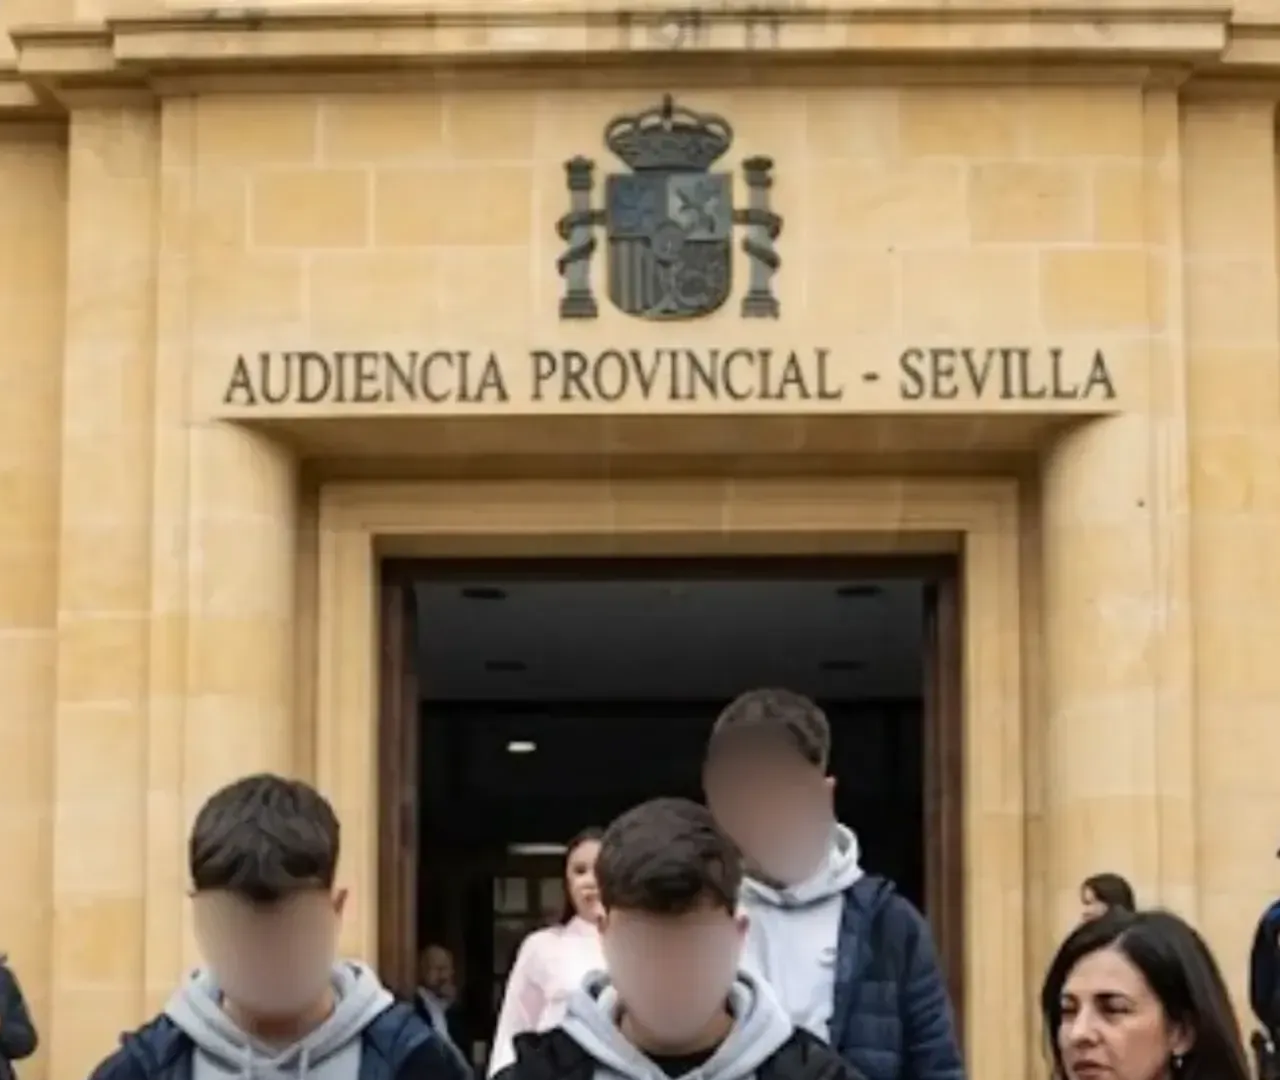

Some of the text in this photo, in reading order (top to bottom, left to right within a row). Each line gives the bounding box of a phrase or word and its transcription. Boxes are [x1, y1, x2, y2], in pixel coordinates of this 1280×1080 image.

[224, 350, 509, 405] AUDIENCIA
[530, 349, 842, 402] PROVINCIAL
[899, 348, 1116, 401] SEVILLA
